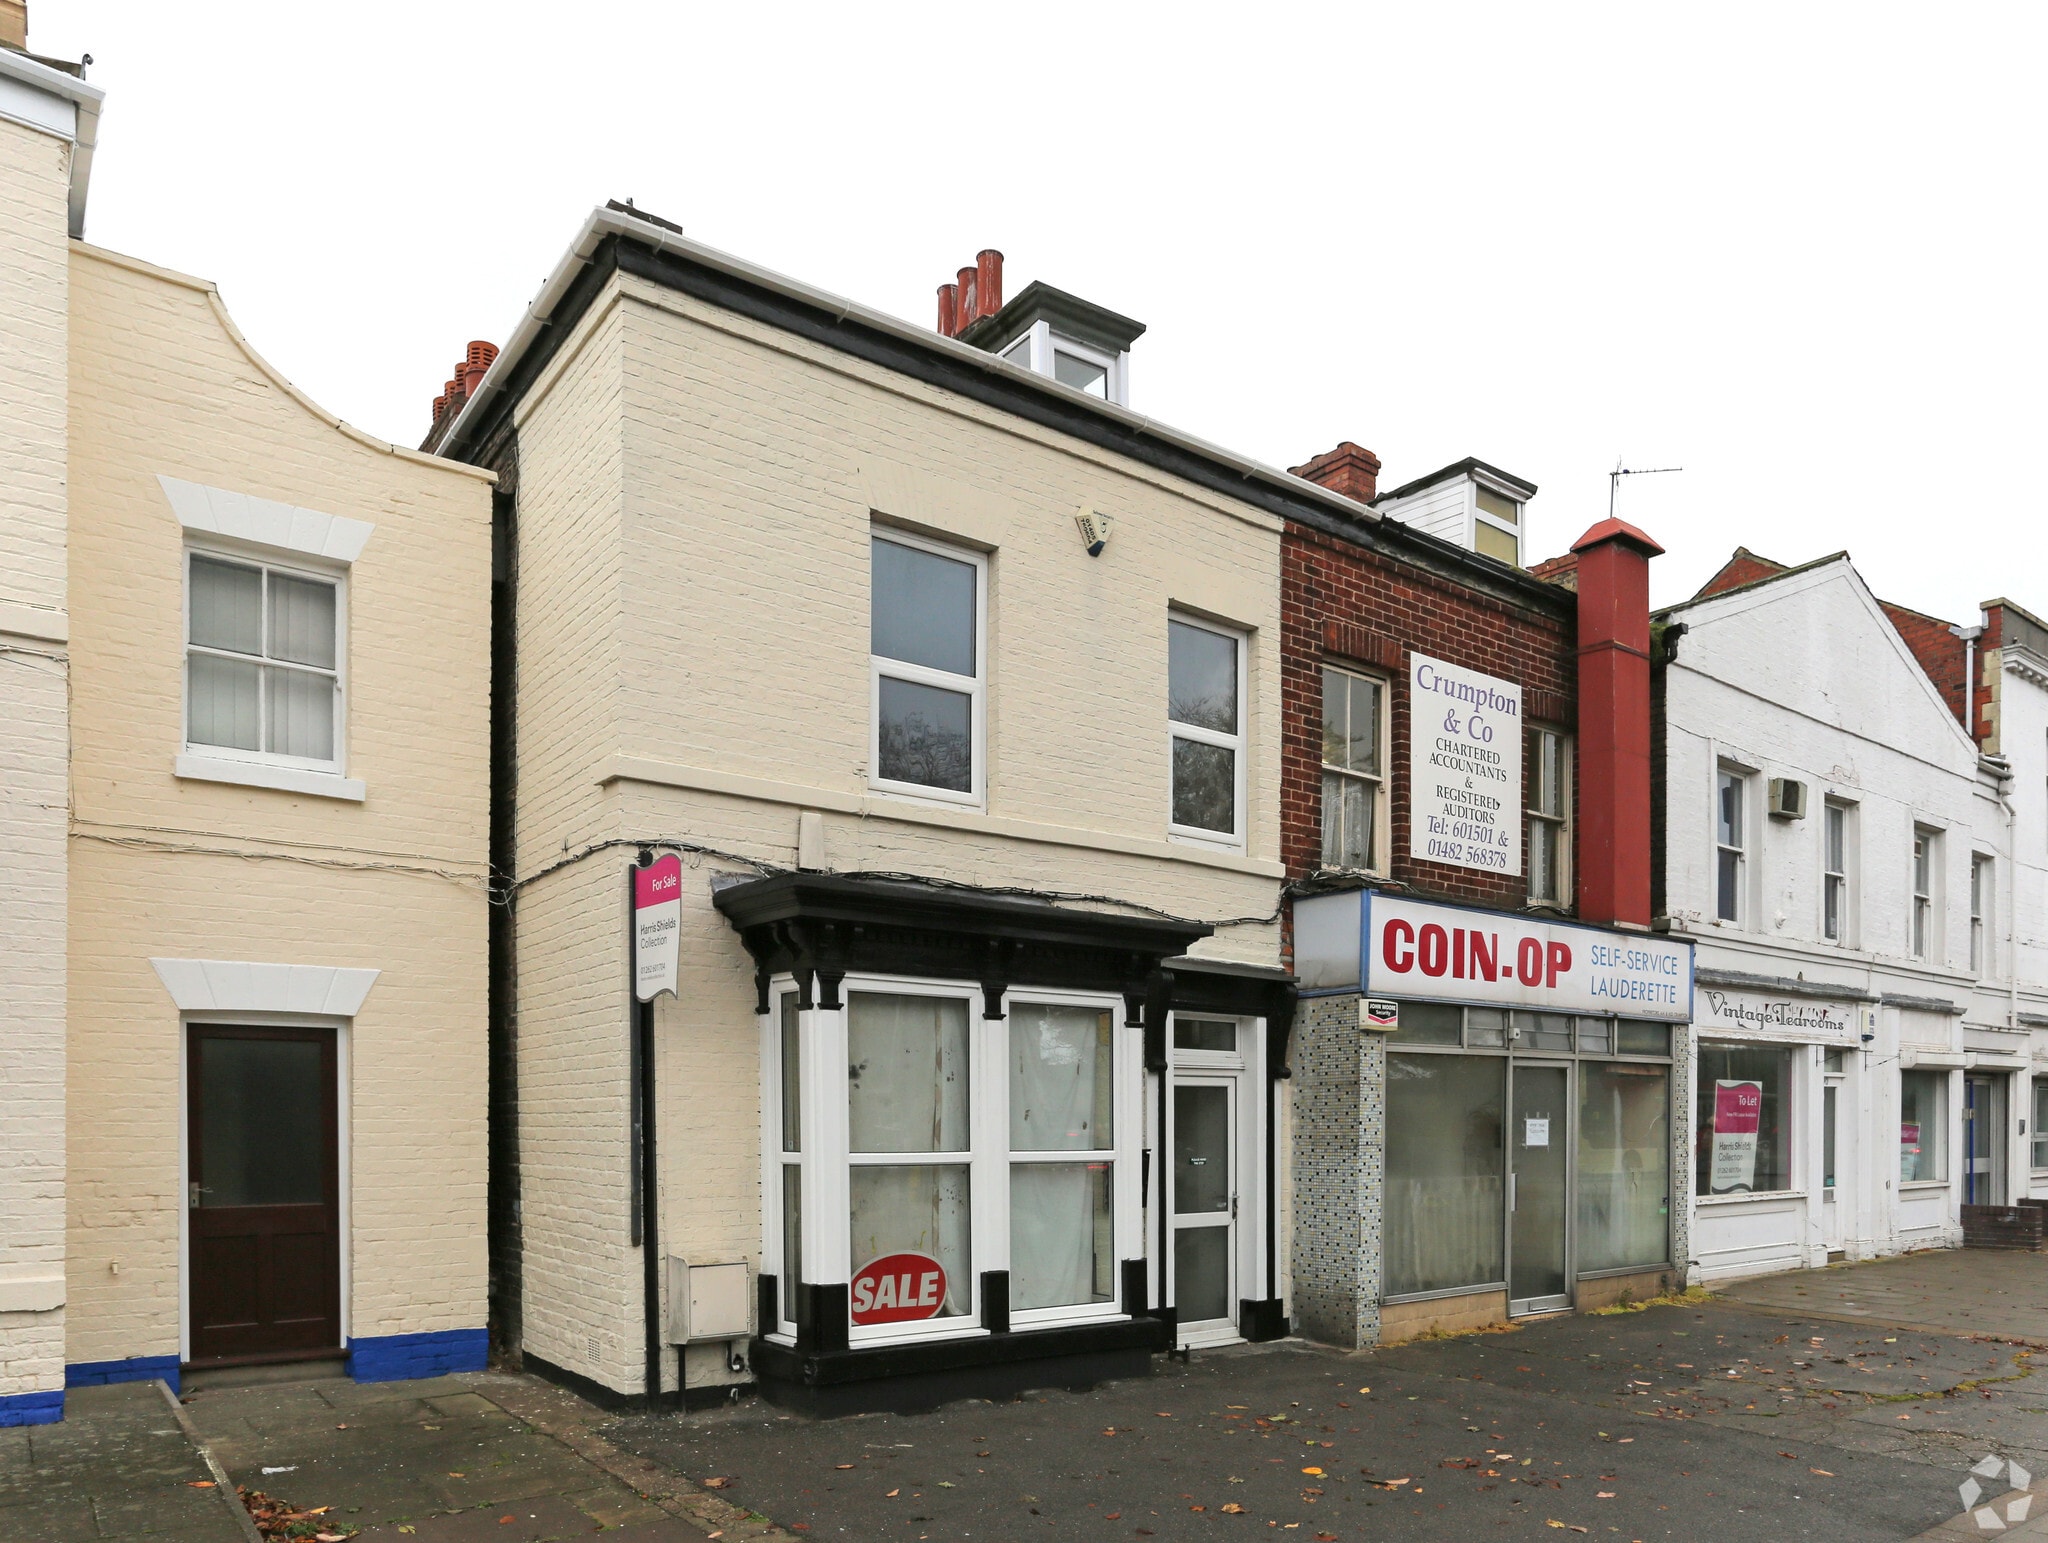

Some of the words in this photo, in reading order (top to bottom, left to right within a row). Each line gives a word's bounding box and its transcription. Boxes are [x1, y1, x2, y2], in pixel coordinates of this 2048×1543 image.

[1417, 665, 1517, 716] Crumpton
[1444, 708, 1460, 734] &
[1468, 716, 1493, 743] Co
[1436, 737, 1501, 765] CHARTERED
[1429, 752, 1507, 782] ACCOUNTANTS
[1465, 776, 1473, 789] &
[1436, 785, 1501, 811] REGISTERED
[1442, 803, 1495, 825] AUDITORS
[1427, 815, 1449, 835] Tel:
[1452, 821, 1494, 844] 601501
[1498, 831, 1509, 847] &
[1428, 839, 1462, 860] 01482
[1465, 846, 1507, 868] 568378
[652, 878, 662, 892] For
[663, 874, 677, 889] Sale
[640, 923, 656, 935] Harris
[657, 917, 676, 932] Shields
[640, 935, 668, 949] Collection
[1591, 944, 1678, 976] SELF-SERVICE
[1591, 975, 1676, 1004] LAUDERETTE
[1704, 991, 1772, 1030] Vintage
[1772, 1002, 1844, 1031] Tearooms
[1738, 1095, 1747, 1106] To
[1747, 1095, 1757, 1106] Let
[852, 1271, 939, 1313] SALE
